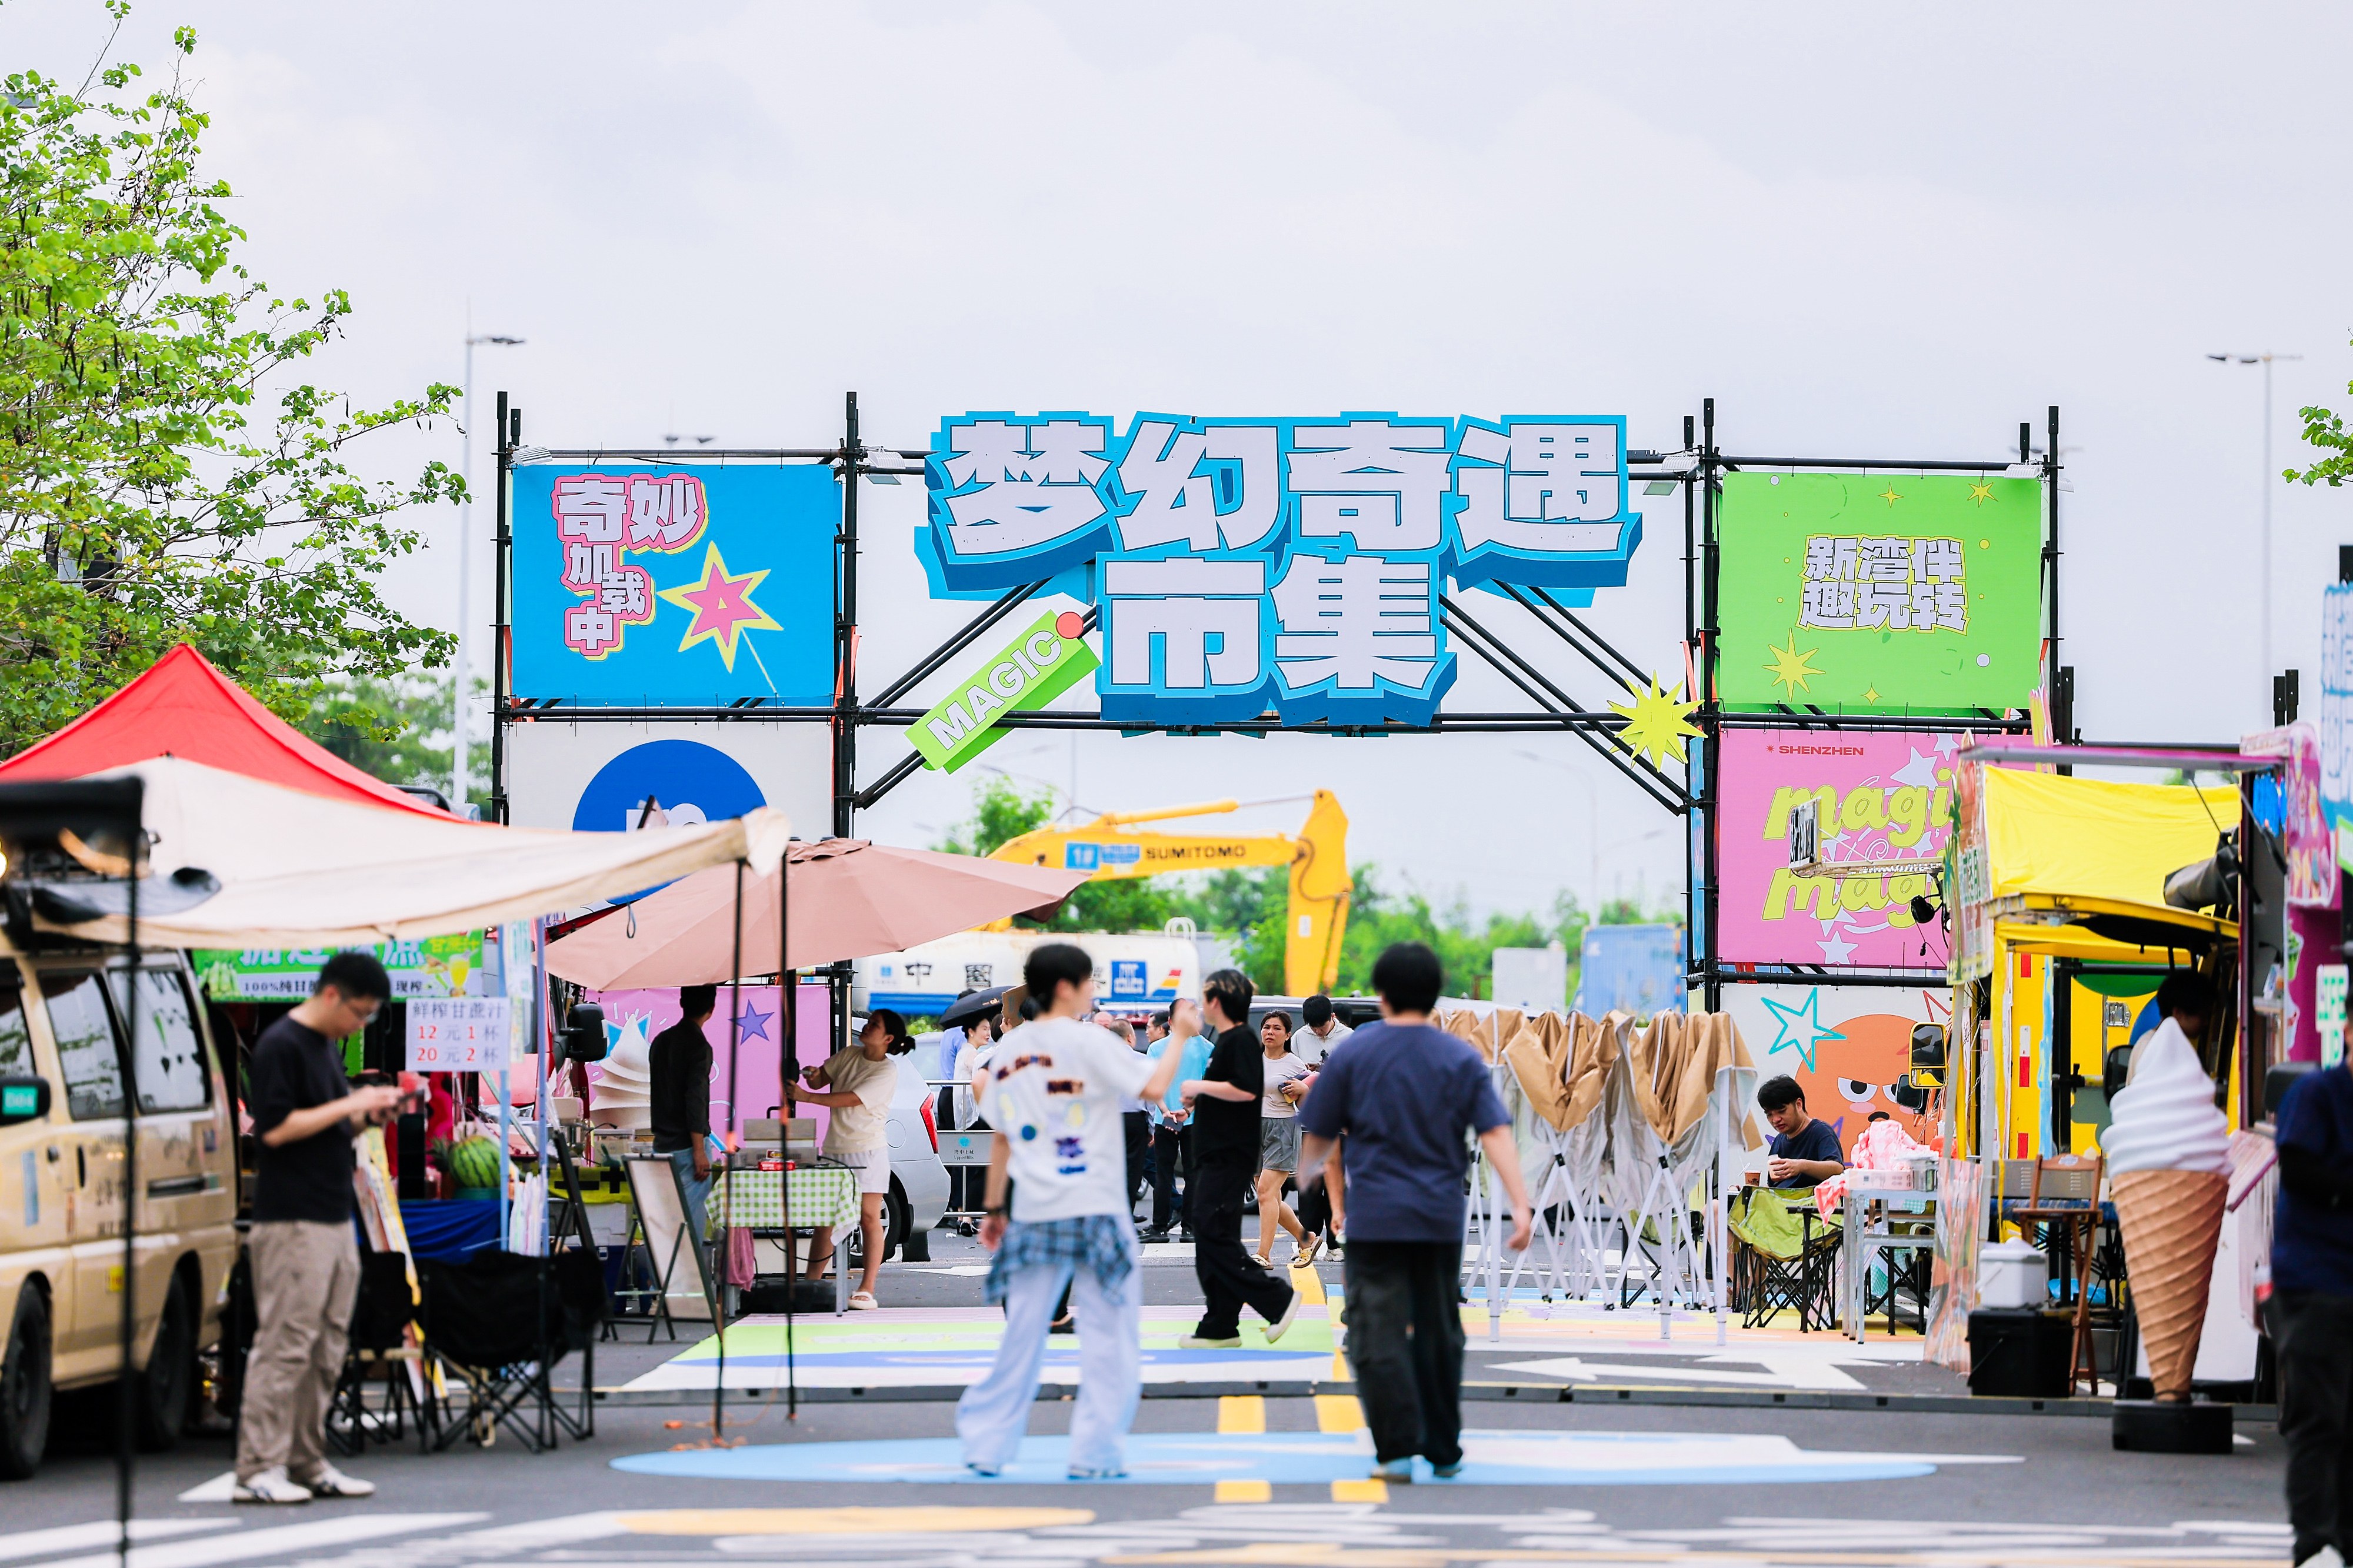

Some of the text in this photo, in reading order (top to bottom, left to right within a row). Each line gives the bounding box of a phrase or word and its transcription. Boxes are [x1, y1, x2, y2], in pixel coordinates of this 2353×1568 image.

[558, 479, 699, 545] 奇妙
[942, 420, 1625, 553] 梦幻奇遇
[1804, 536, 1964, 582] 新湾伴
[1104, 554, 1440, 689] 市集
[1799, 581, 1966, 631] 趣玩转
[925, 630, 1062, 750] MAGIC
[1779, 745, 1864, 756] SHENZHEN
[1146, 845, 1247, 859] SUMITOMO
